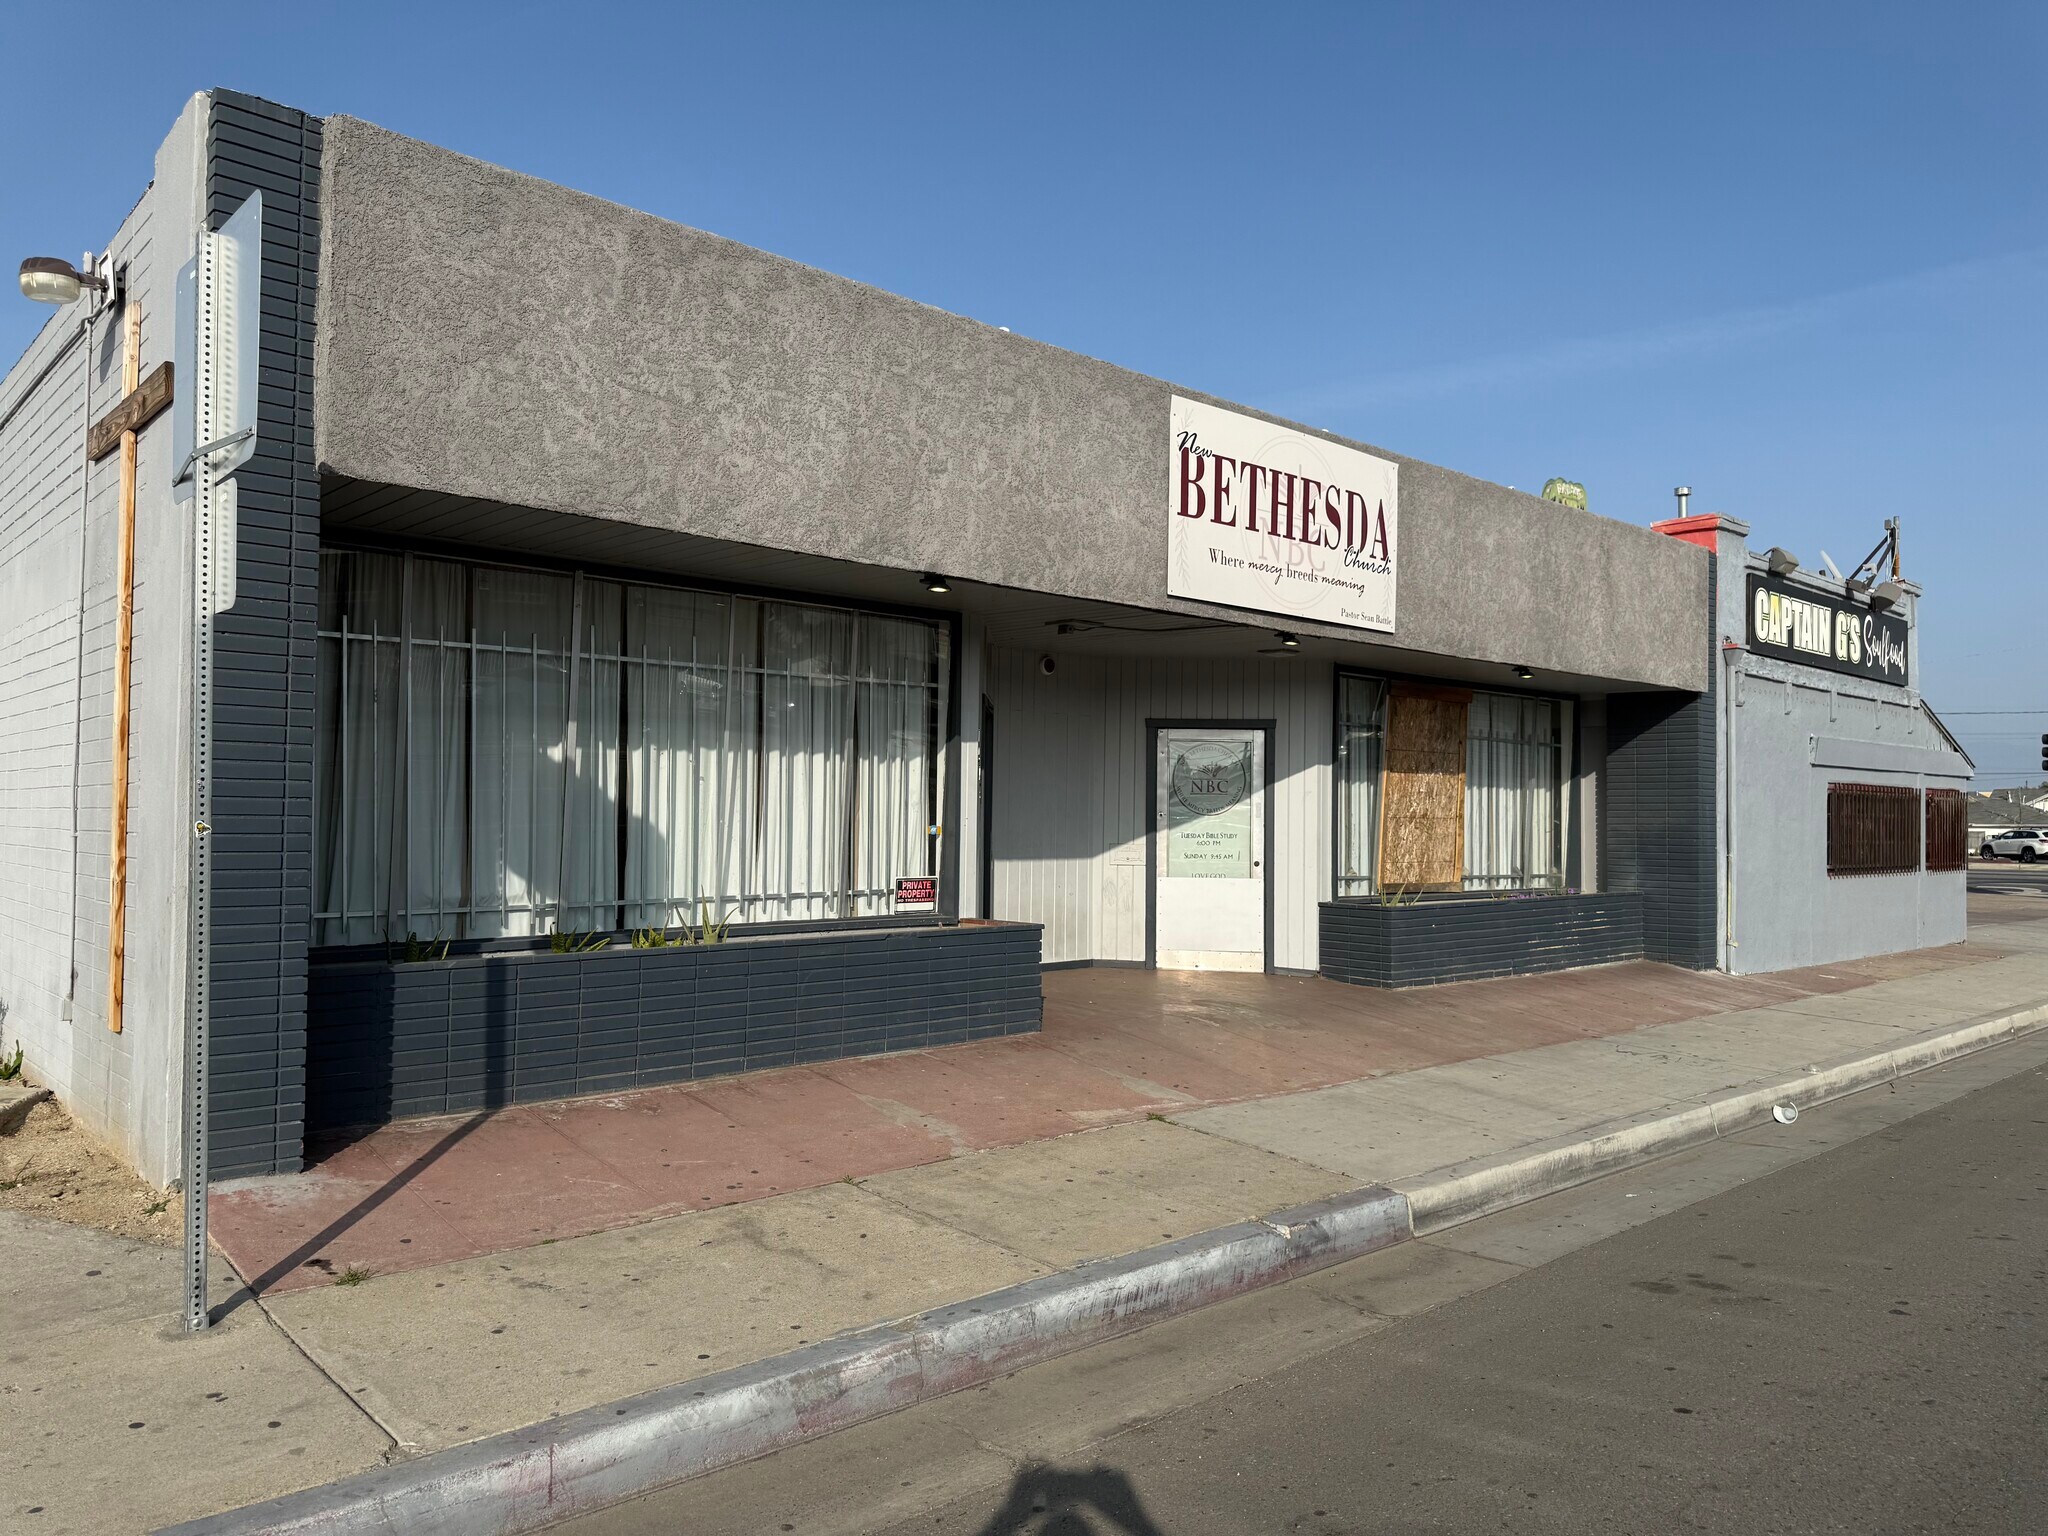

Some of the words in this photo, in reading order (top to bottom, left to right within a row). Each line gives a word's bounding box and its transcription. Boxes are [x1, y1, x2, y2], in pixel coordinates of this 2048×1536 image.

[1177, 430, 1214, 458] New
[1177, 447, 1390, 562] BETHESDA
[1209, 547, 1245, 569] Where
[1248, 561, 1284, 585] mercy
[1286, 563, 1319, 584] breeds
[1321, 575, 1365, 598] meaning
[1343, 545, 1392, 575] Church
[1340, 607, 1360, 620] Pastor
[1361, 611, 1375, 622] Sean
[1375, 614, 1392, 626] Battle
[1754, 587, 1832, 658] CAPTAIN
[1835, 610, 1862, 664] G'S
[1863, 614, 1906, 676] Soulfood
[1191, 780, 1229, 794] NBC
[897, 889, 935, 898] PROPERTY
[902, 881, 932, 889] PRIVATE
